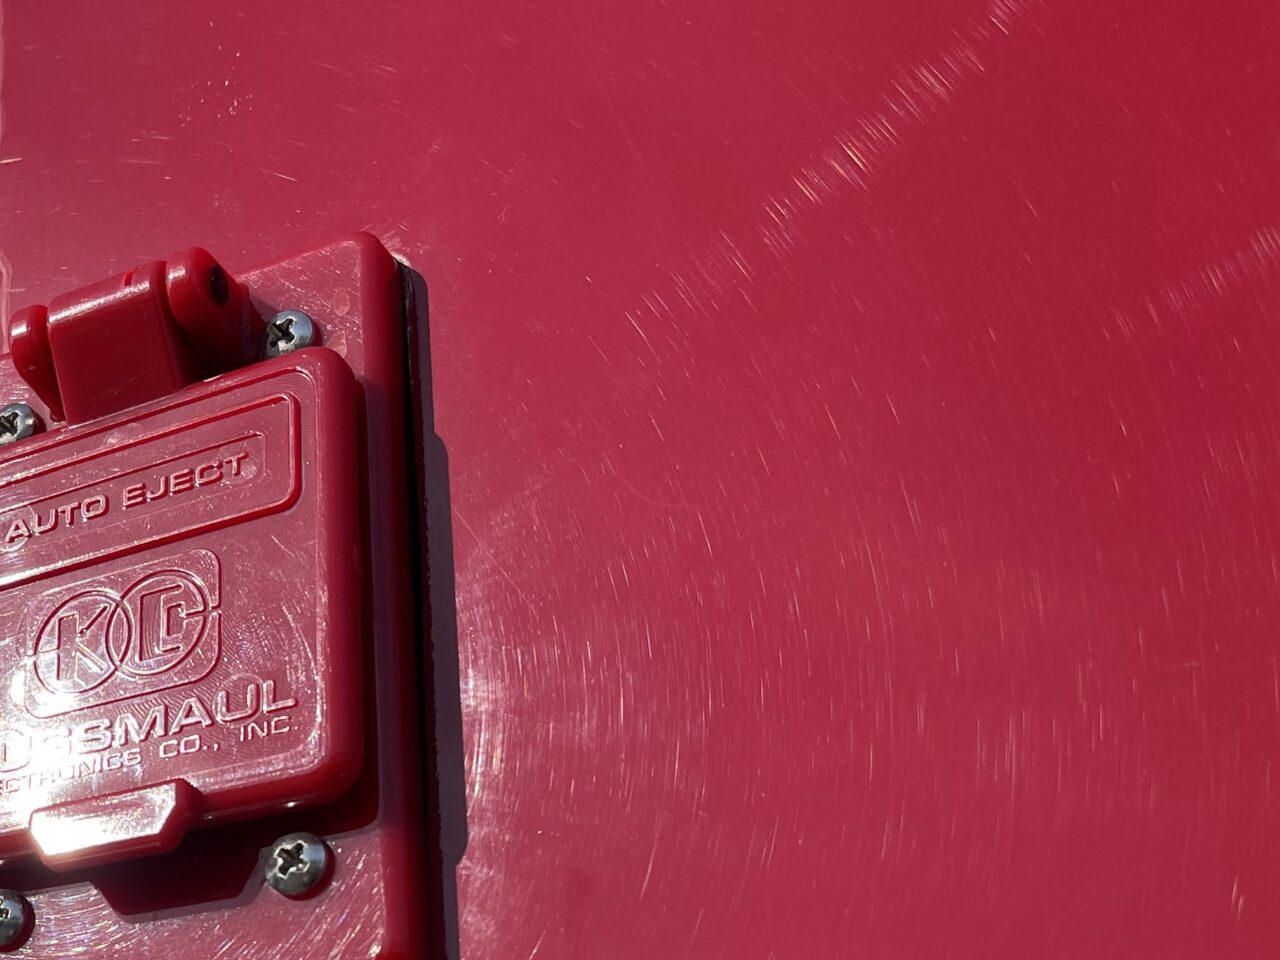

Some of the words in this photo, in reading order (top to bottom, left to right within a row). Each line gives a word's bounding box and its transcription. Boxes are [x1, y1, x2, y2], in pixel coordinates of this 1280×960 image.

[4, 493, 111, 544] AUTO
[121, 451, 252, 510] EJECT
[238, 714, 300, 743] INC.
